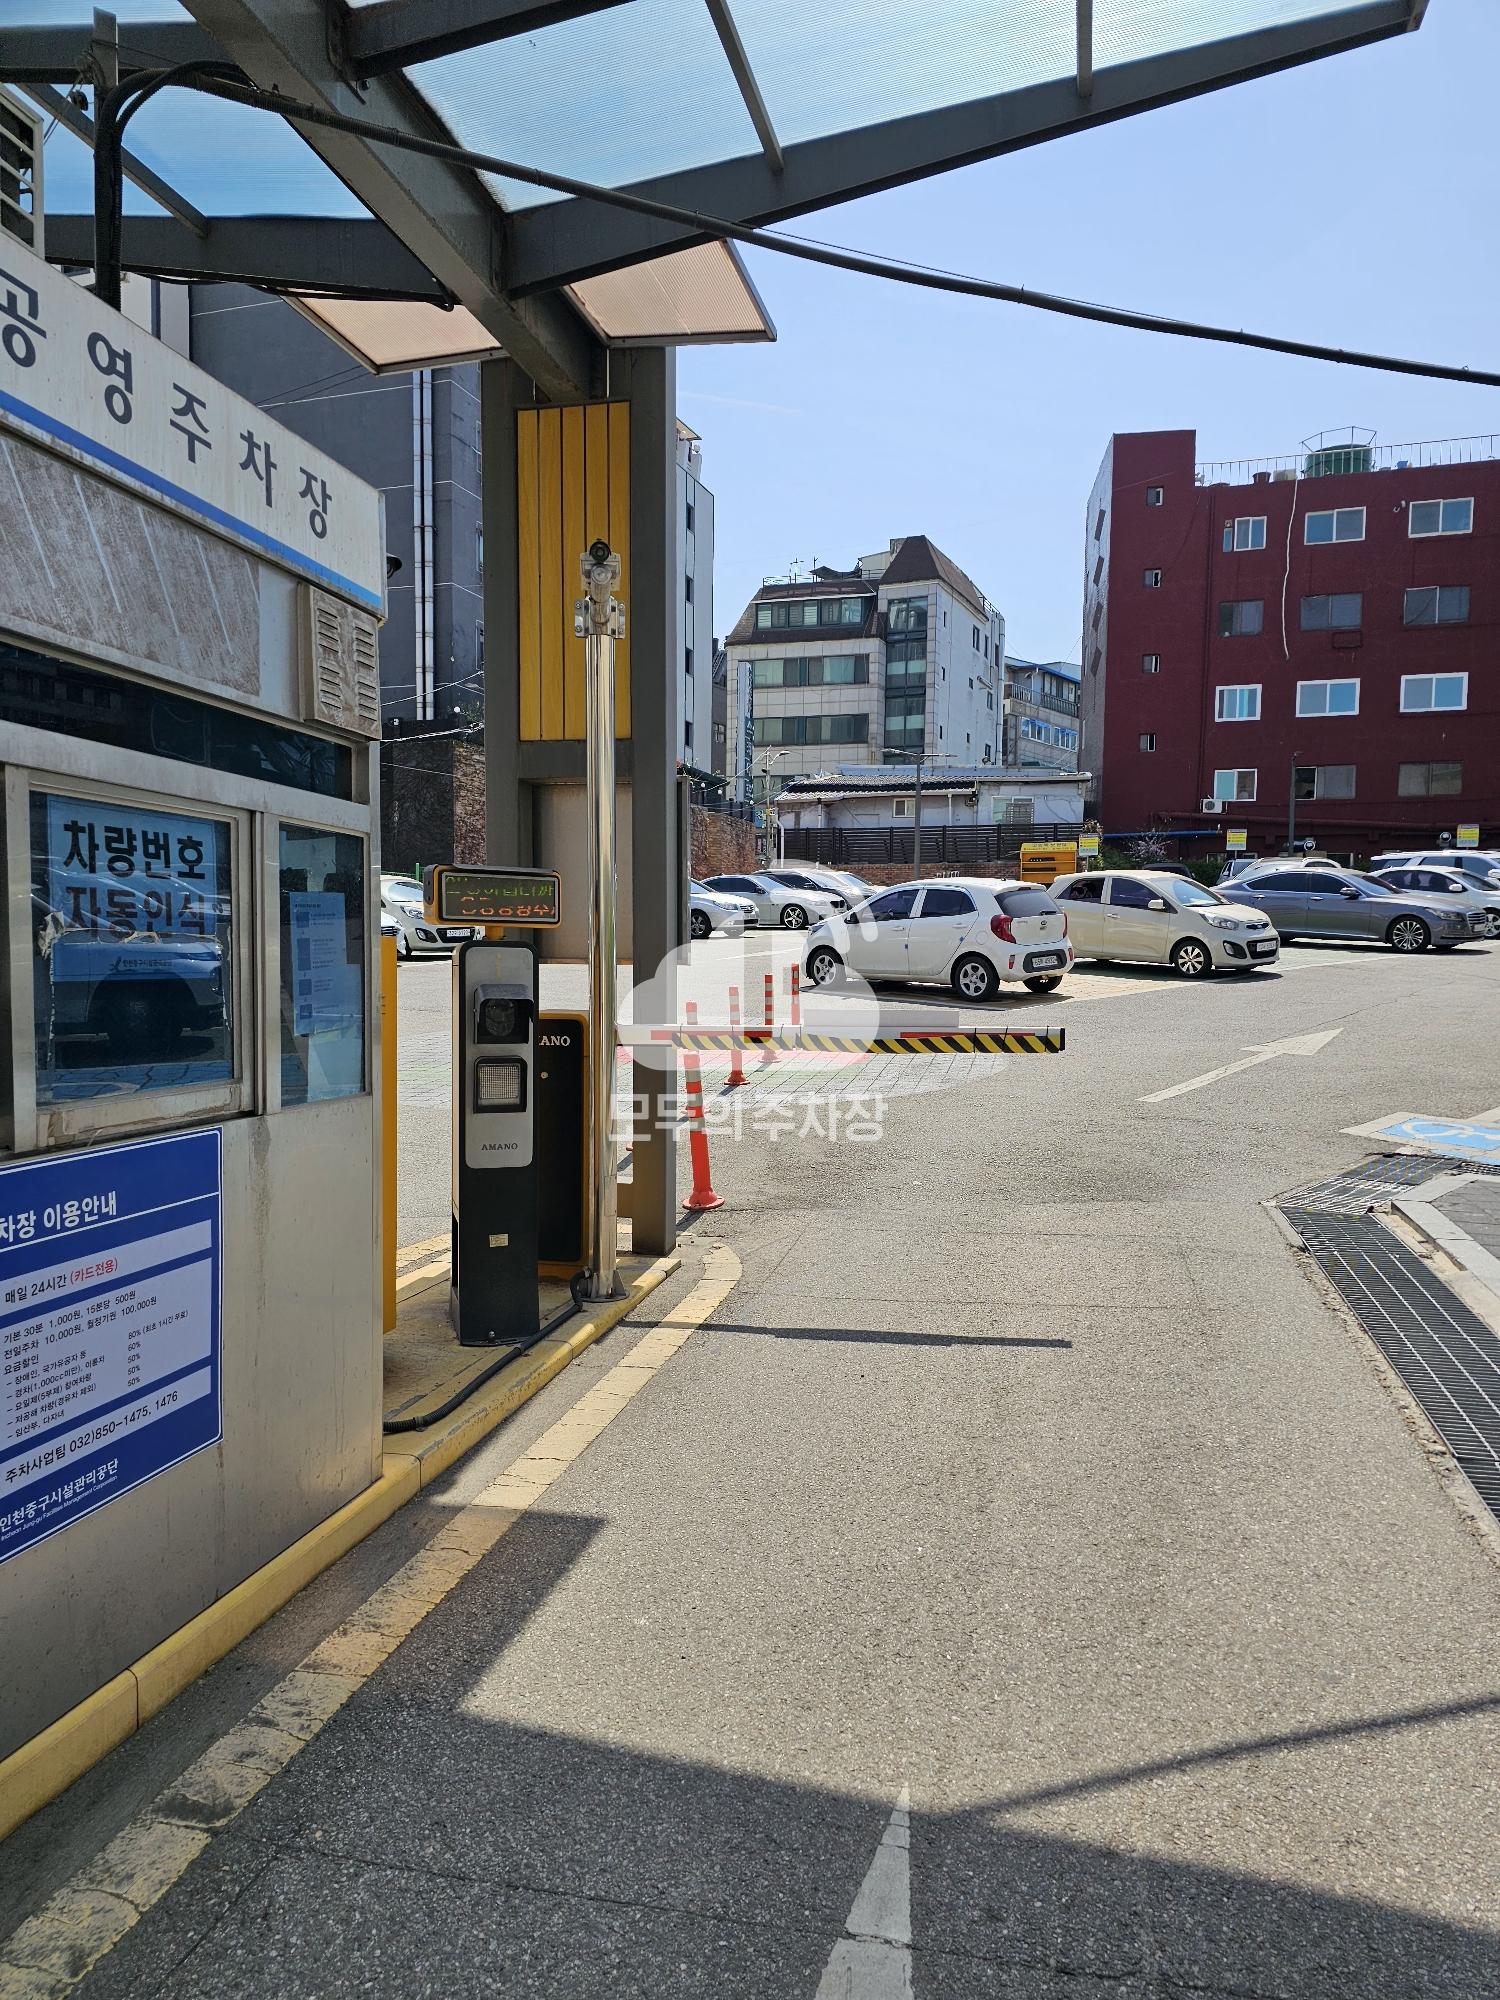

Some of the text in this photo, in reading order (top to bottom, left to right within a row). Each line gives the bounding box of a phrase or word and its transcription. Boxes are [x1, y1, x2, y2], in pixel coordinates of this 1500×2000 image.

[0, 268, 332, 539] 공영주차장
[63, 820, 206, 881] 차량번호
[65, 886, 206, 940] 자동인식
[539, 1036, 571, 1047] ANO
[481, 1142, 519, 1151] AMANO
[43, 1190, 117, 1230] 이용안내
[5, 1257, 118, 1304] 매일 24시간 (카드전용)
[4, 1331, 21, 1344] 기본
[24, 1322, 44, 1338] 30분
[87, 1298, 110, 1315] 15분당
[115, 1290, 136, 1305] 500원
[3, 1353, 39, 1376] 요금할인
[5, 1444, 66, 1483] 주차사업팀
[155, 1390, 178, 1411] 1476
[0, 1458, 119, 1533] 인천중구시설관리공단
